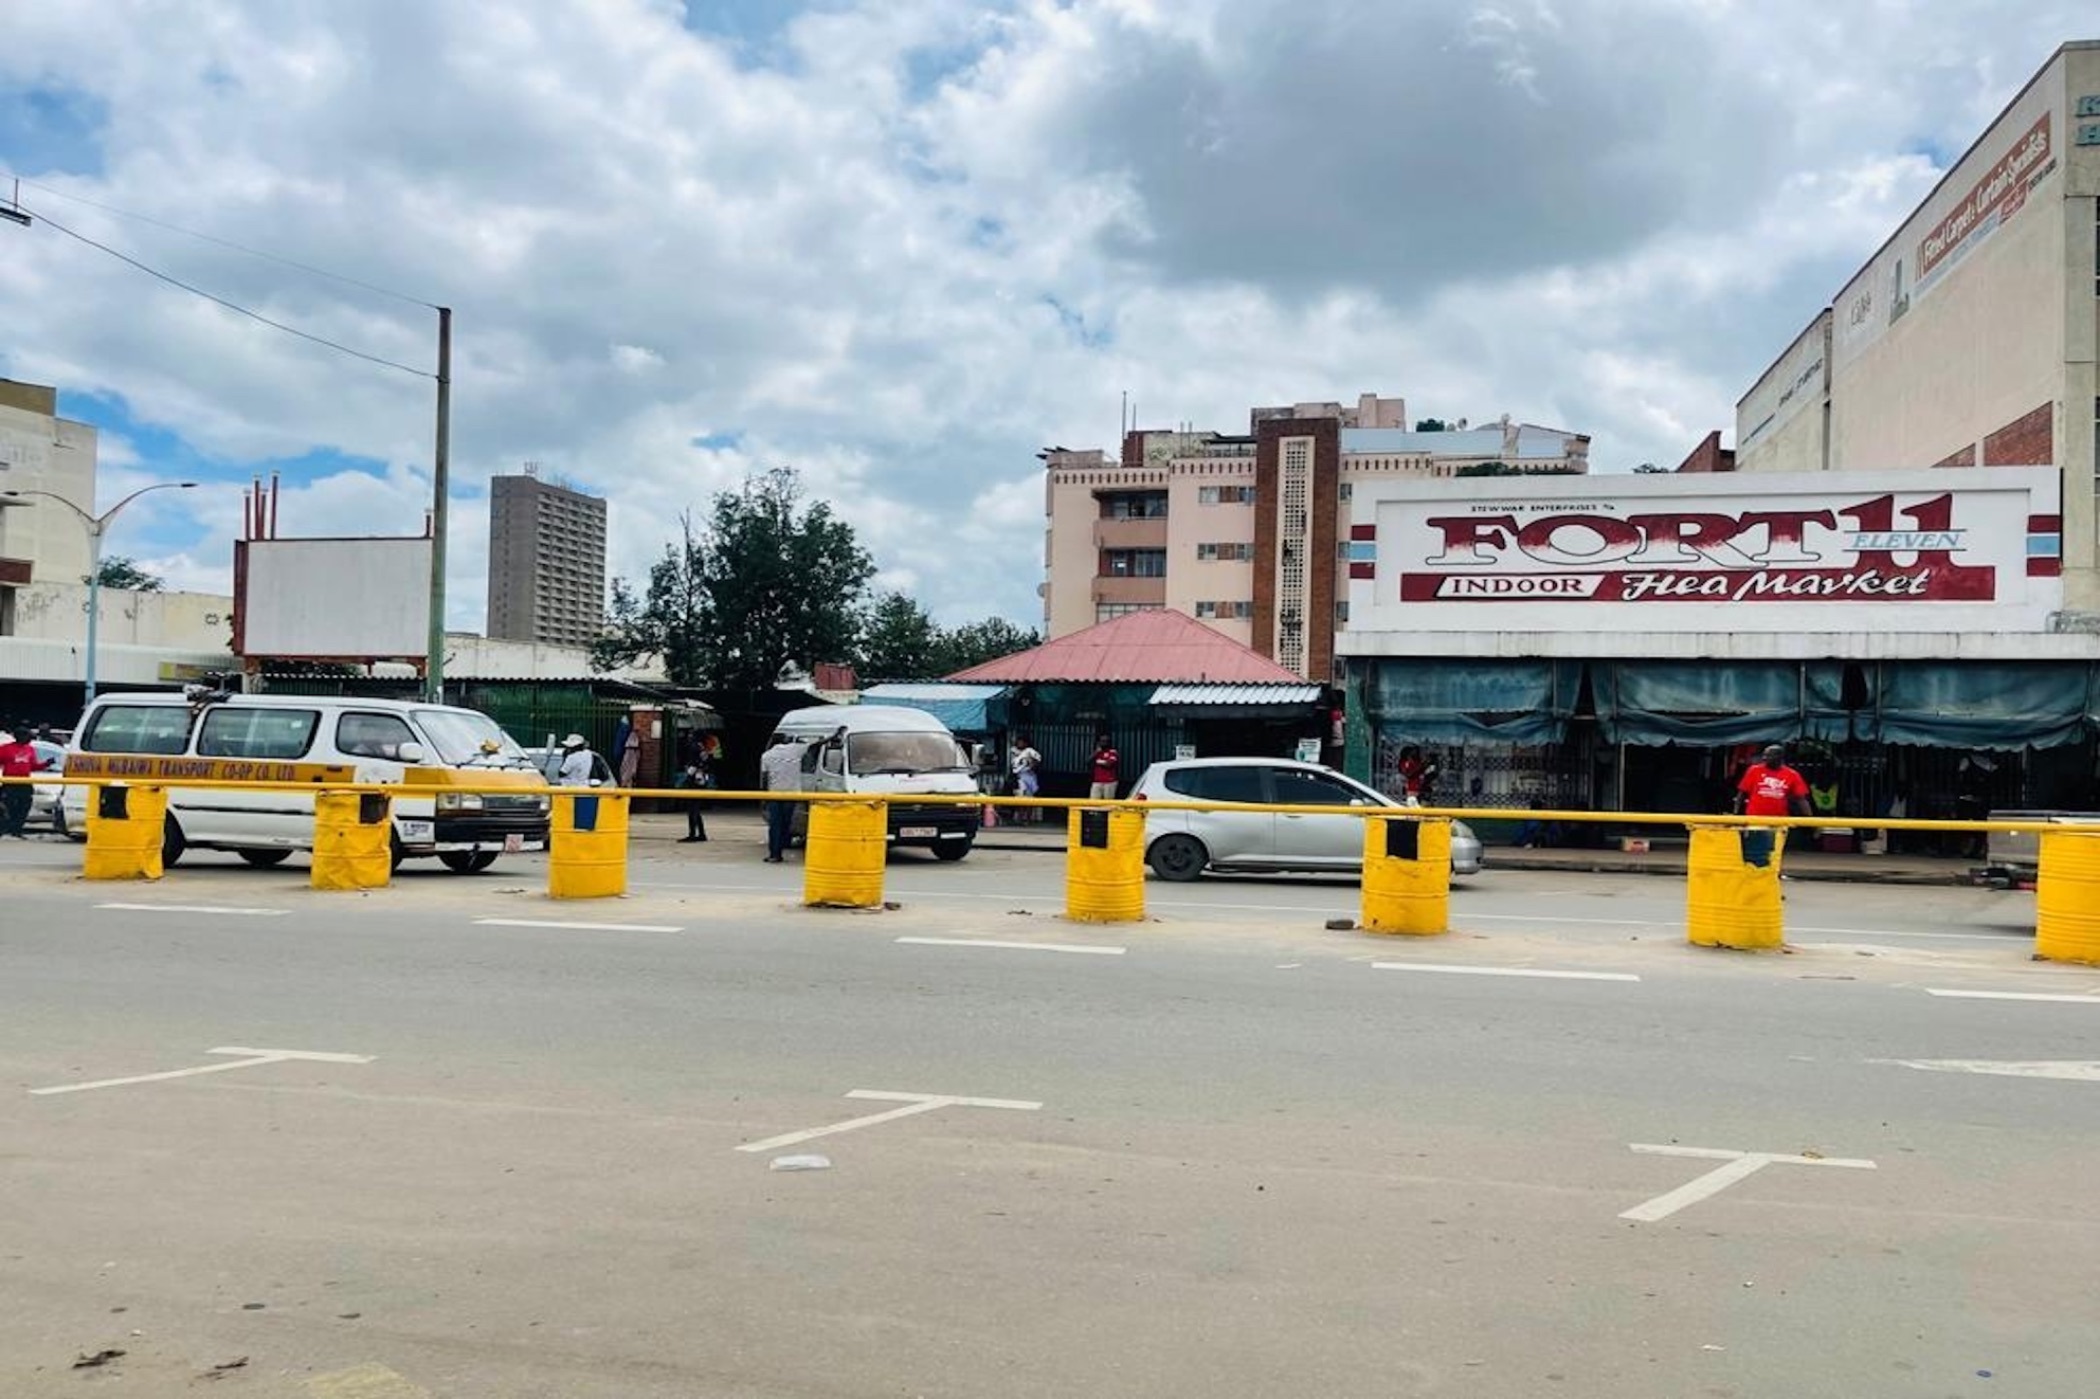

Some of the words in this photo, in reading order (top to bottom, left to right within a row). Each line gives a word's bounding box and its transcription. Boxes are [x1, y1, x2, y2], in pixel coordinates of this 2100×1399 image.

[1424, 510, 1838, 569] FORT
[1838, 493, 1953, 566] 11
[1853, 532, 1961, 549] ELEVEN
[1452, 578, 1585, 594] INDOOR
[1621, 572, 1729, 601] Flea
[1731, 568, 1930, 601] Market
[159, 760, 215, 778] TRANSPORT
